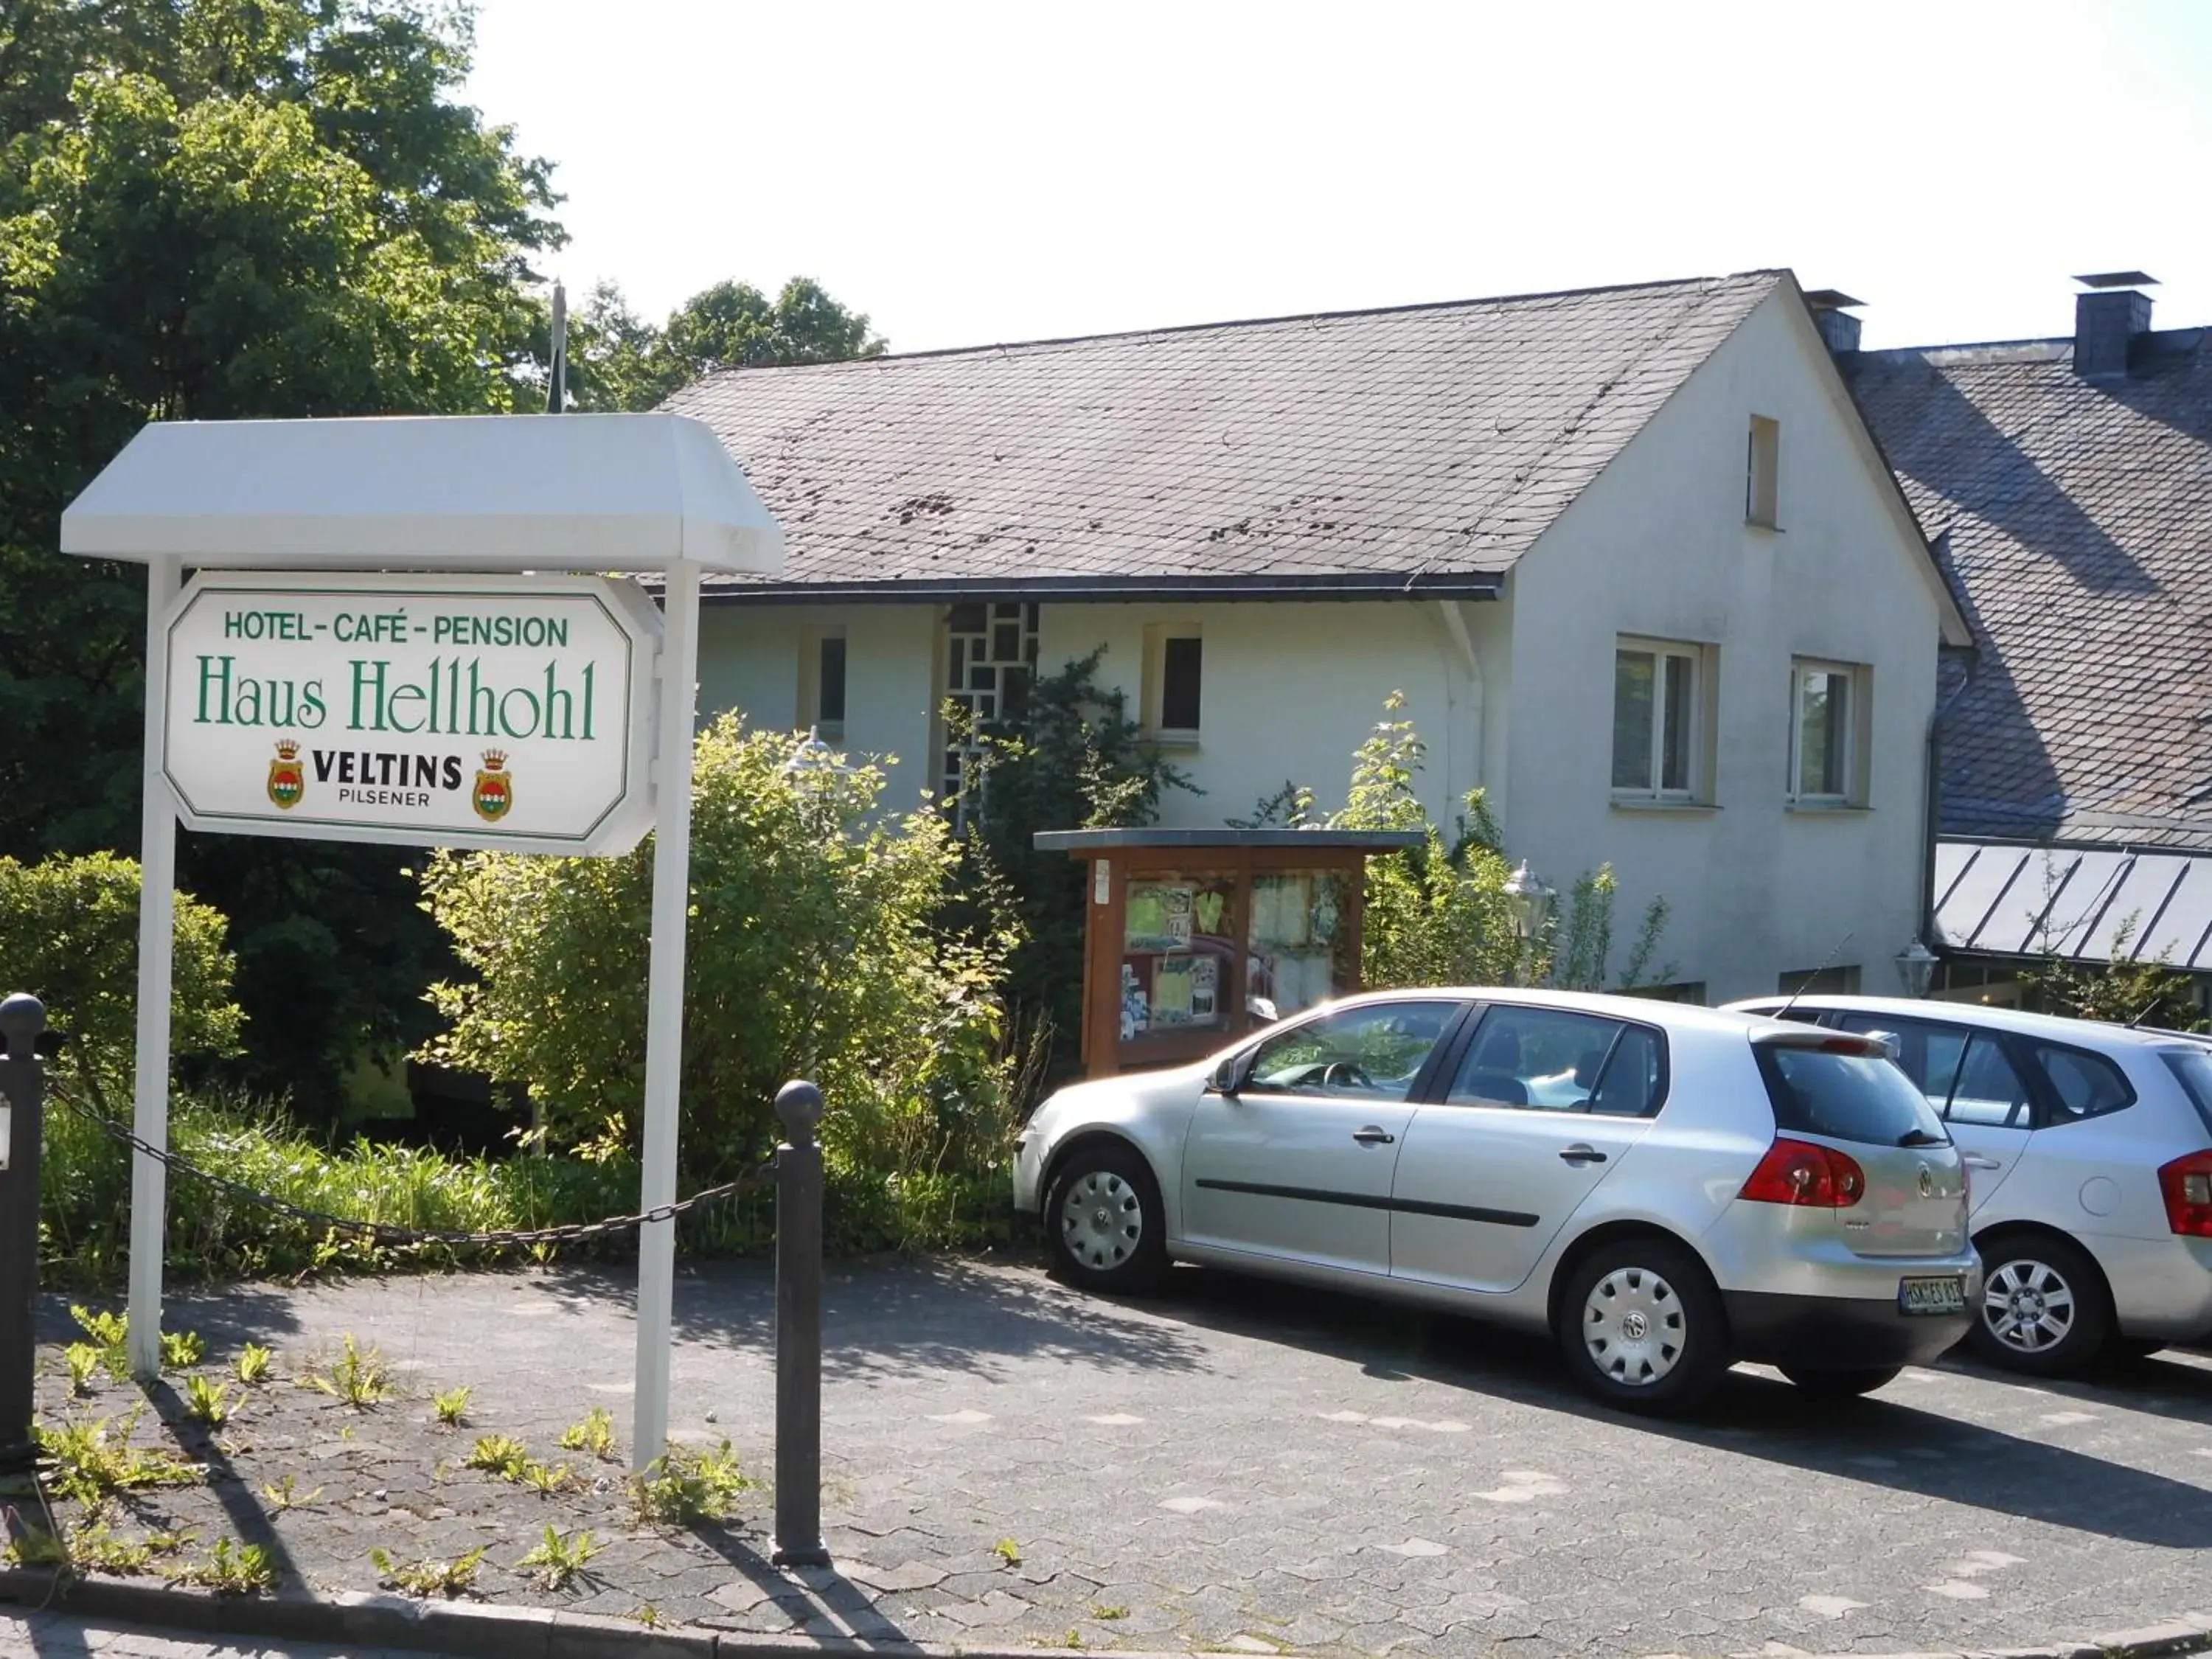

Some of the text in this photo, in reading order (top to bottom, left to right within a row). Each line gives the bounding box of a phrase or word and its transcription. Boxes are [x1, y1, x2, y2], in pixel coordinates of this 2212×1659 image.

[192, 655, 596, 741] Haus Hellhohl
[313, 750, 462, 791] VELTINS
[338, 788, 430, 807] PILSENER
